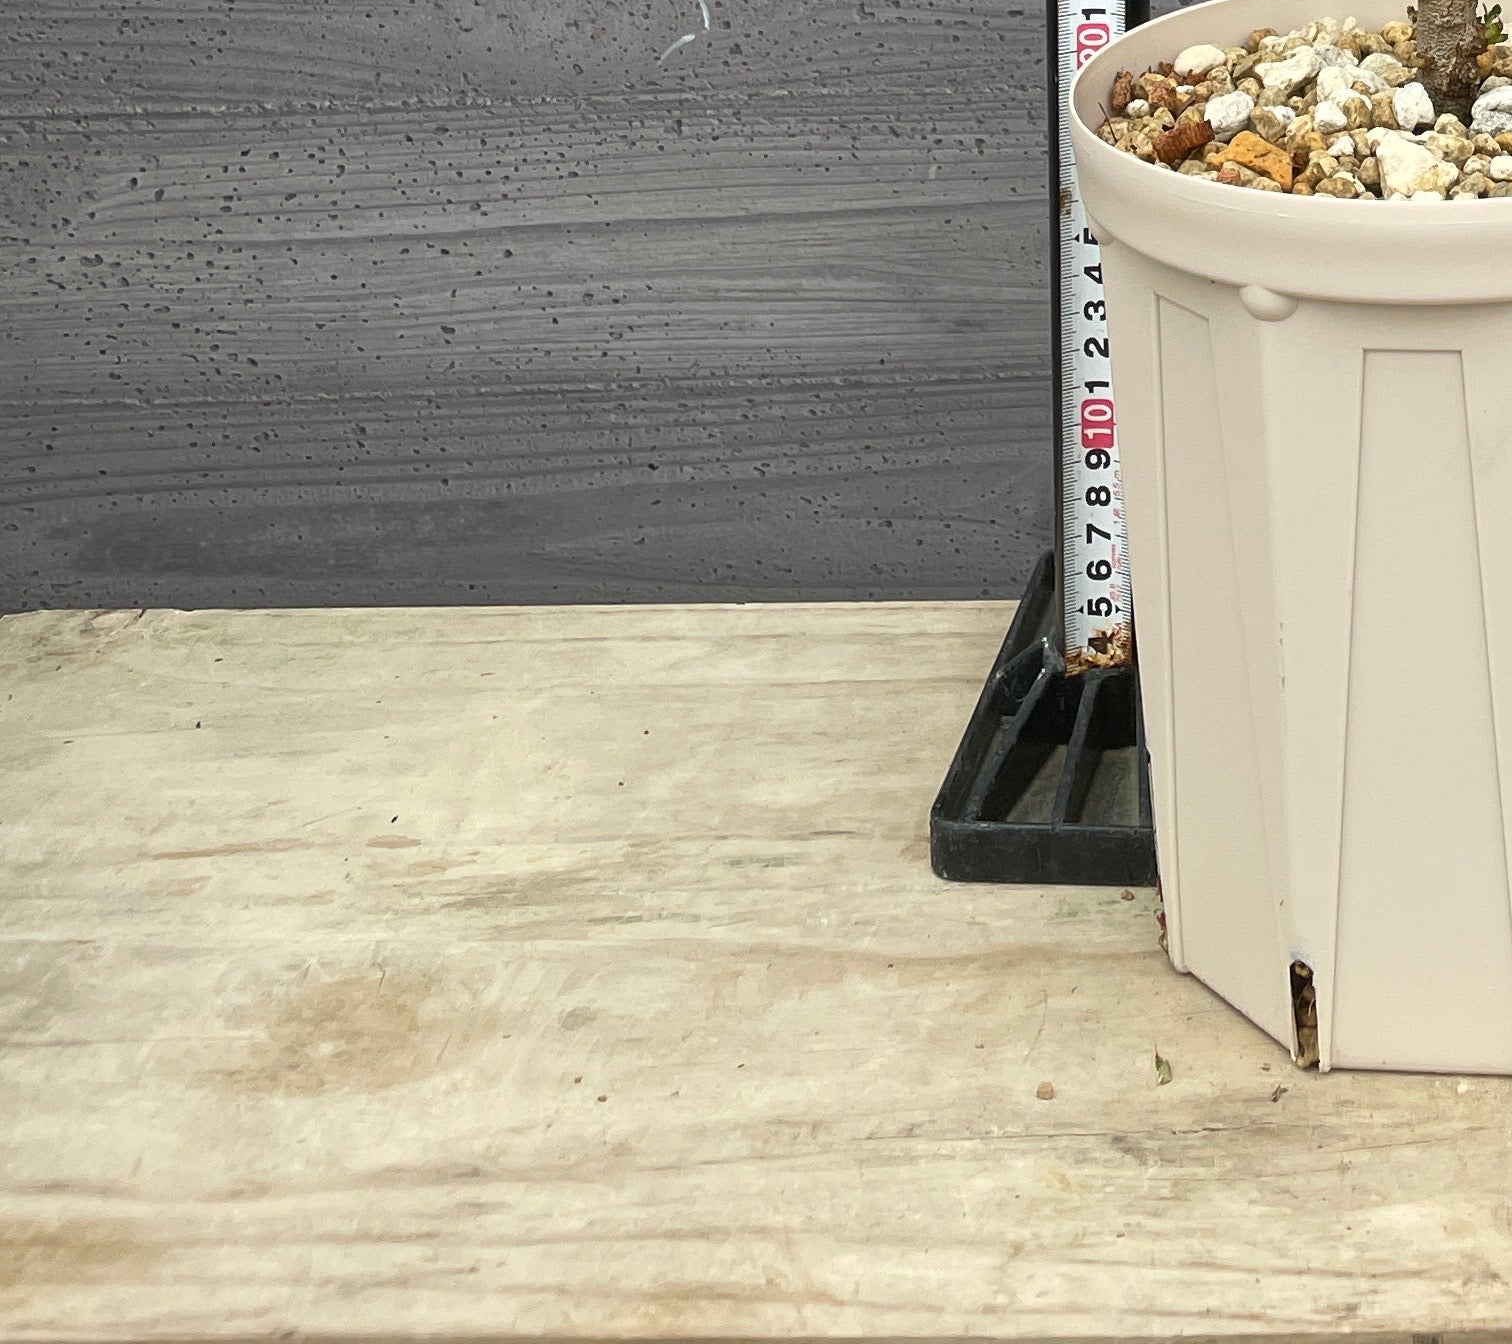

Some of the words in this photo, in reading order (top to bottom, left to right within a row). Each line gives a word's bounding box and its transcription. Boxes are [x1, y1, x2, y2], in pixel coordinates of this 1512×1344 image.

[1082, 9, 1106, 20] 1
[1084, 263, 1103, 284] 4
[1084, 300, 1106, 321] 3
[1084, 338, 1109, 358] 2
[1085, 381, 1109, 393] 1
[1084, 404, 1112, 439] 10
[1085, 448, 1110, 470] 9
[1086, 486, 1111, 506] 8
[1086, 524, 1111, 544] 7
[1086, 560, 1112, 580] 6
[1087, 597, 1112, 617] 5
